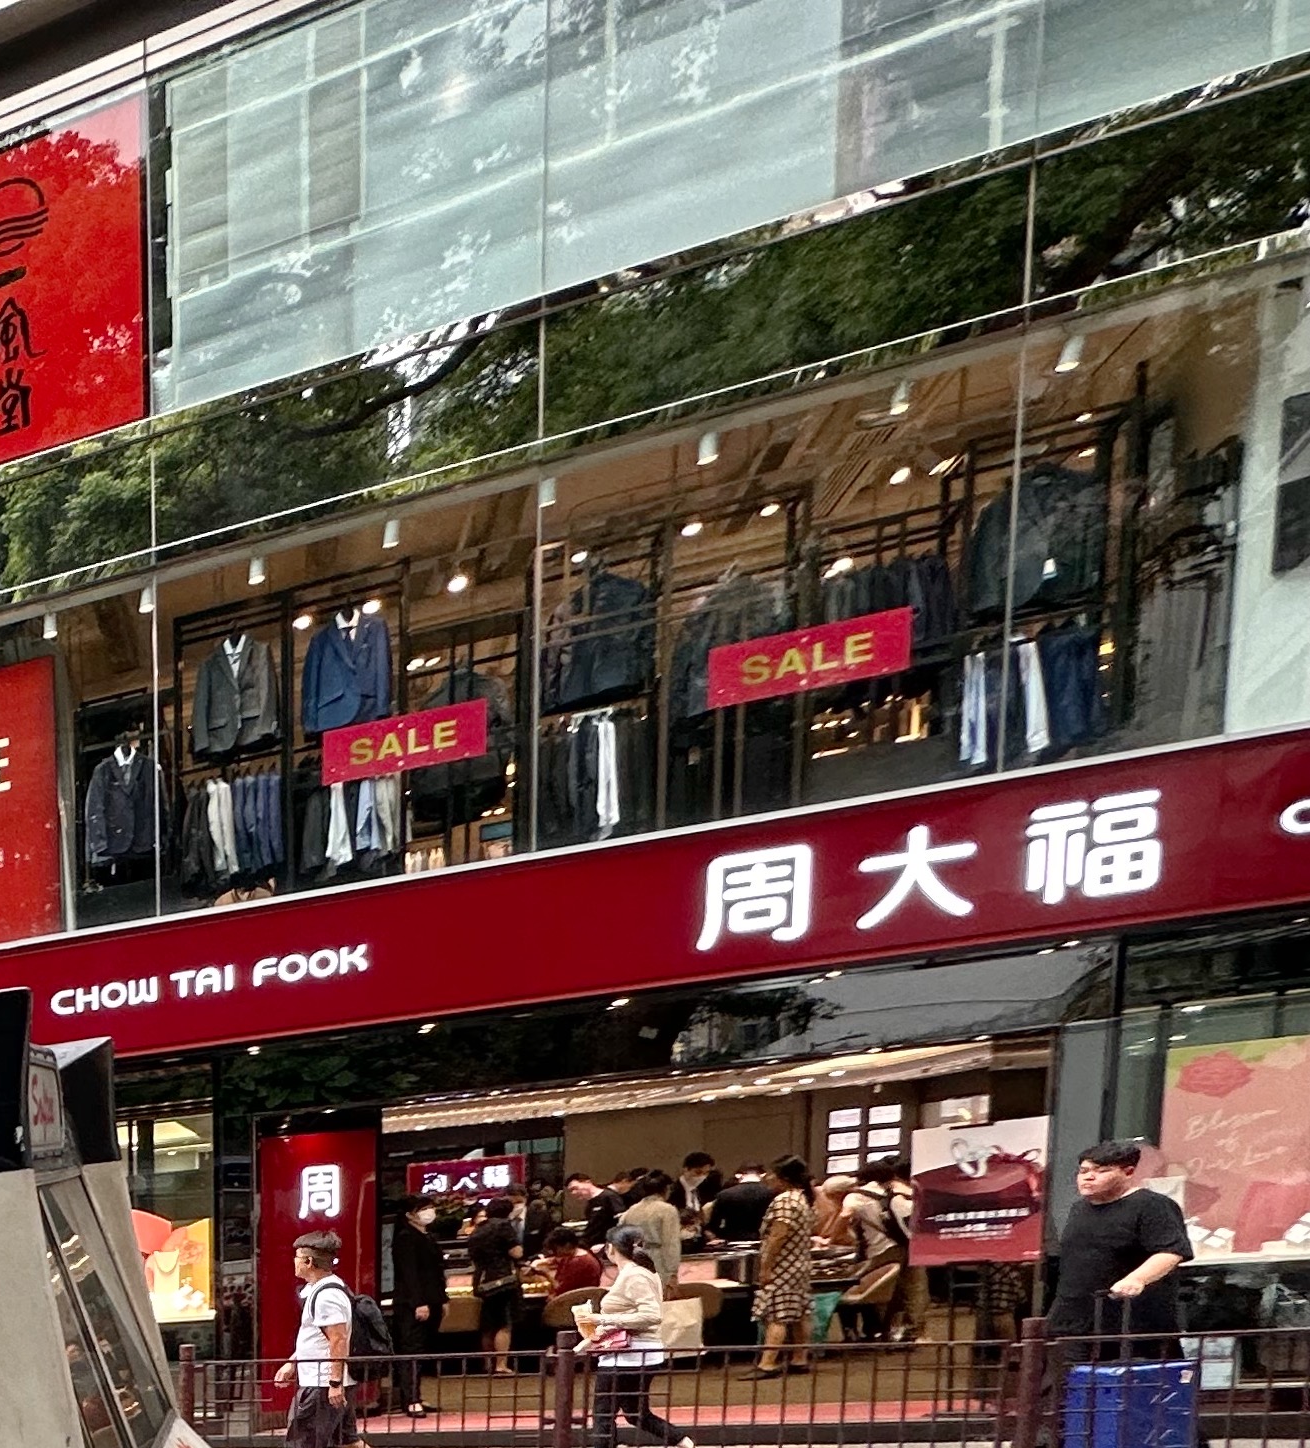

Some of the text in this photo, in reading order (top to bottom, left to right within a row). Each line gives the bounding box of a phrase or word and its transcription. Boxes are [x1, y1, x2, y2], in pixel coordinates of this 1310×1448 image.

[741, 630, 874, 686] SALE
[349, 718, 459, 766] SALE
[695, 788, 1163, 952] 周大福
[50, 943, 371, 1016] CHOW TAI FOOK
[298, 1163, 341, 1220] 周
